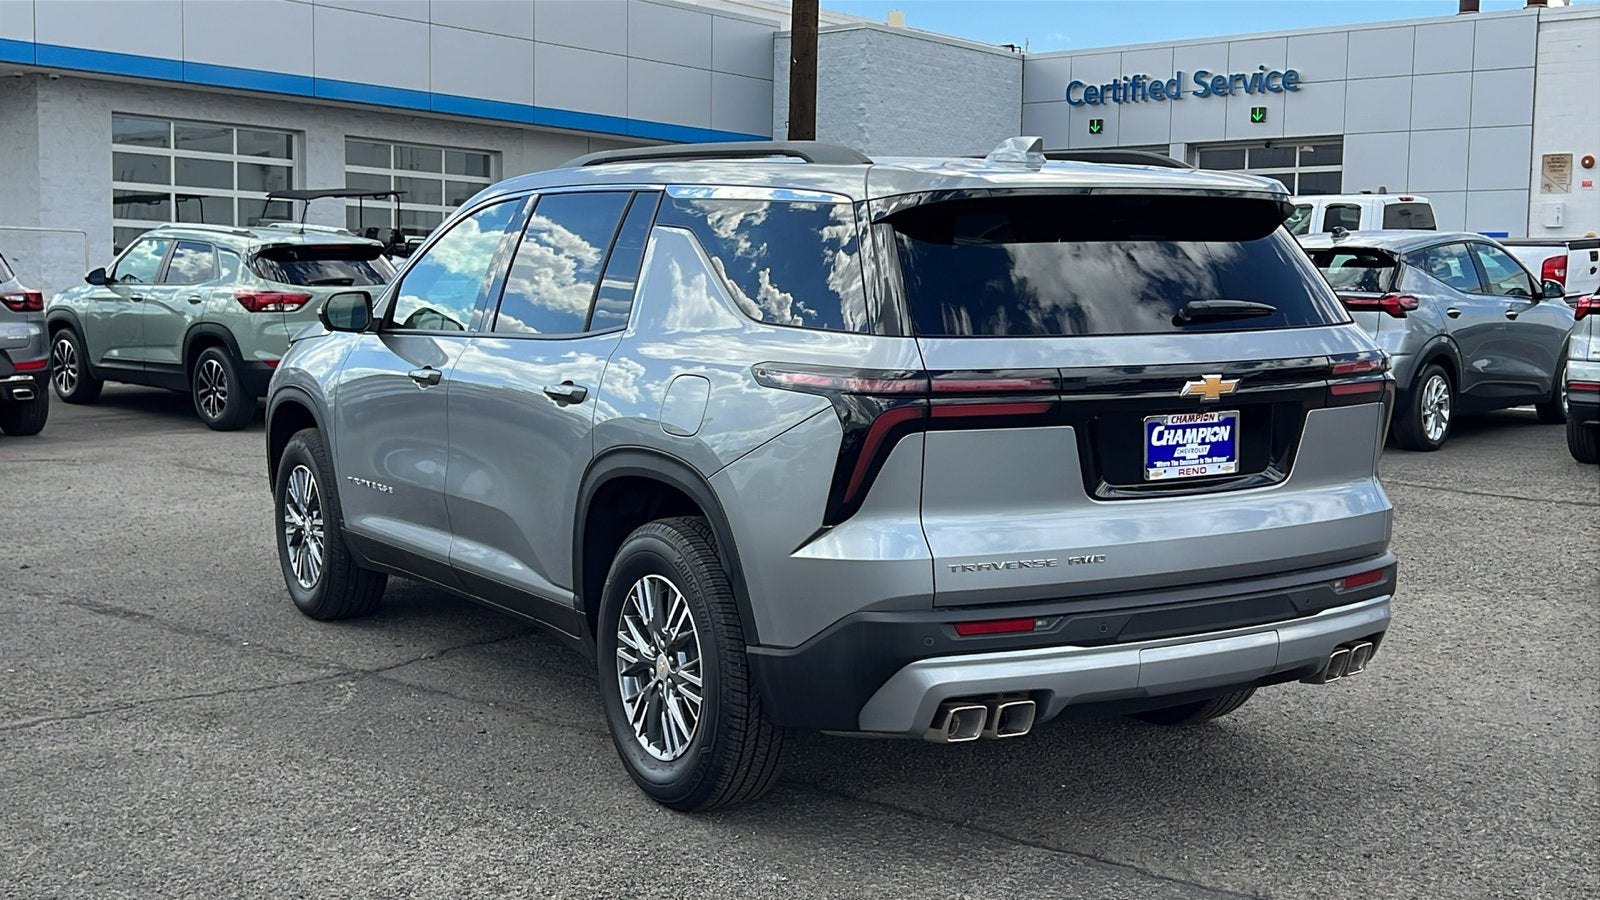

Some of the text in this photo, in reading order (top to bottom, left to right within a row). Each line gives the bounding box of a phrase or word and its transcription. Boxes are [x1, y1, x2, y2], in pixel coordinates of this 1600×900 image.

[1066, 65, 1301, 107] Certified Service
[1171, 413, 1216, 424] CHAMPION
[1151, 425, 1231, 446] CHAMPION
[1176, 446, 1208, 455] CHEVROLET
[1178, 466, 1207, 477] RENO
[947, 554, 1106, 573] TRAVERSE AWD
[674, 556, 711, 633] BRIDGESTONE
